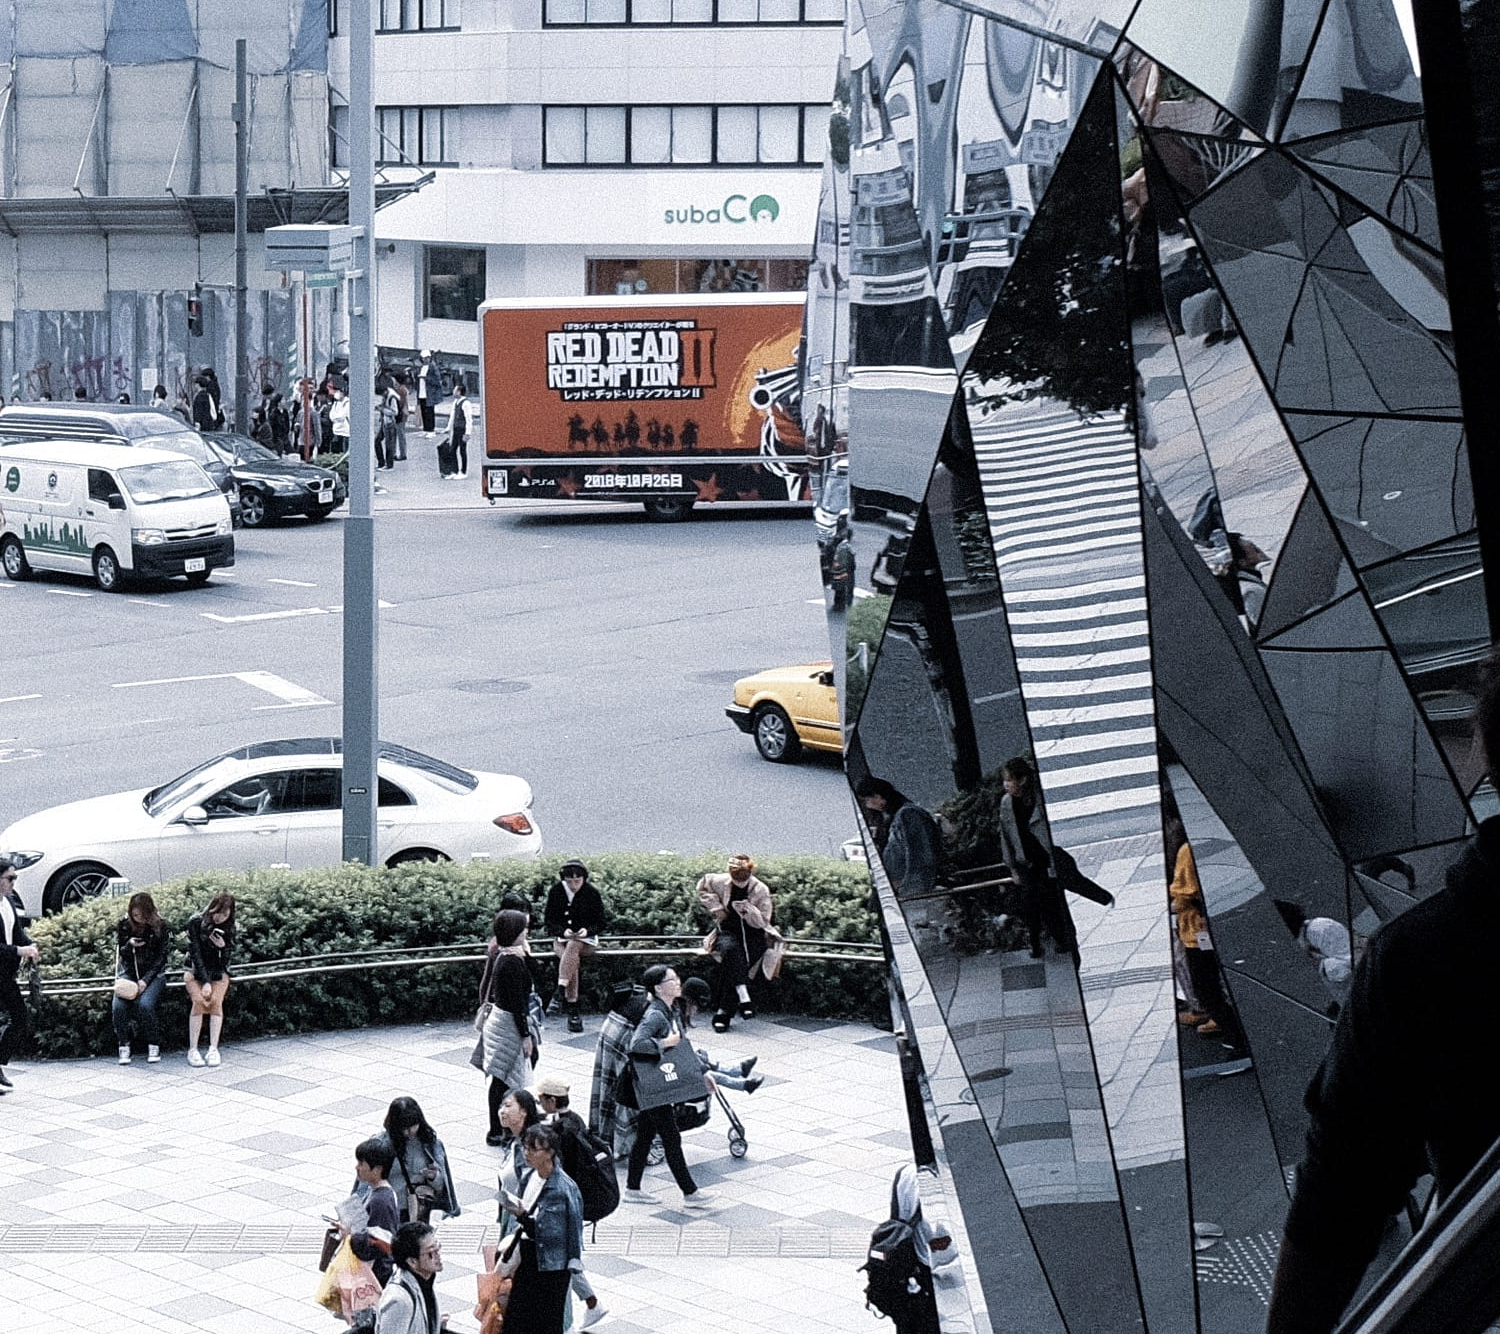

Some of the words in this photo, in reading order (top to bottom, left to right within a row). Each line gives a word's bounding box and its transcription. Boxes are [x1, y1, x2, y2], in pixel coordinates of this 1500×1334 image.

[548, 332, 601, 364] RED
[606, 330, 679, 364] DEAD
[548, 363, 679, 388] REDEMPTION
[680, 330, 715, 387] II
[531, 478, 557, 487] PS4
[584, 473, 683, 488] 2018年10月26日
